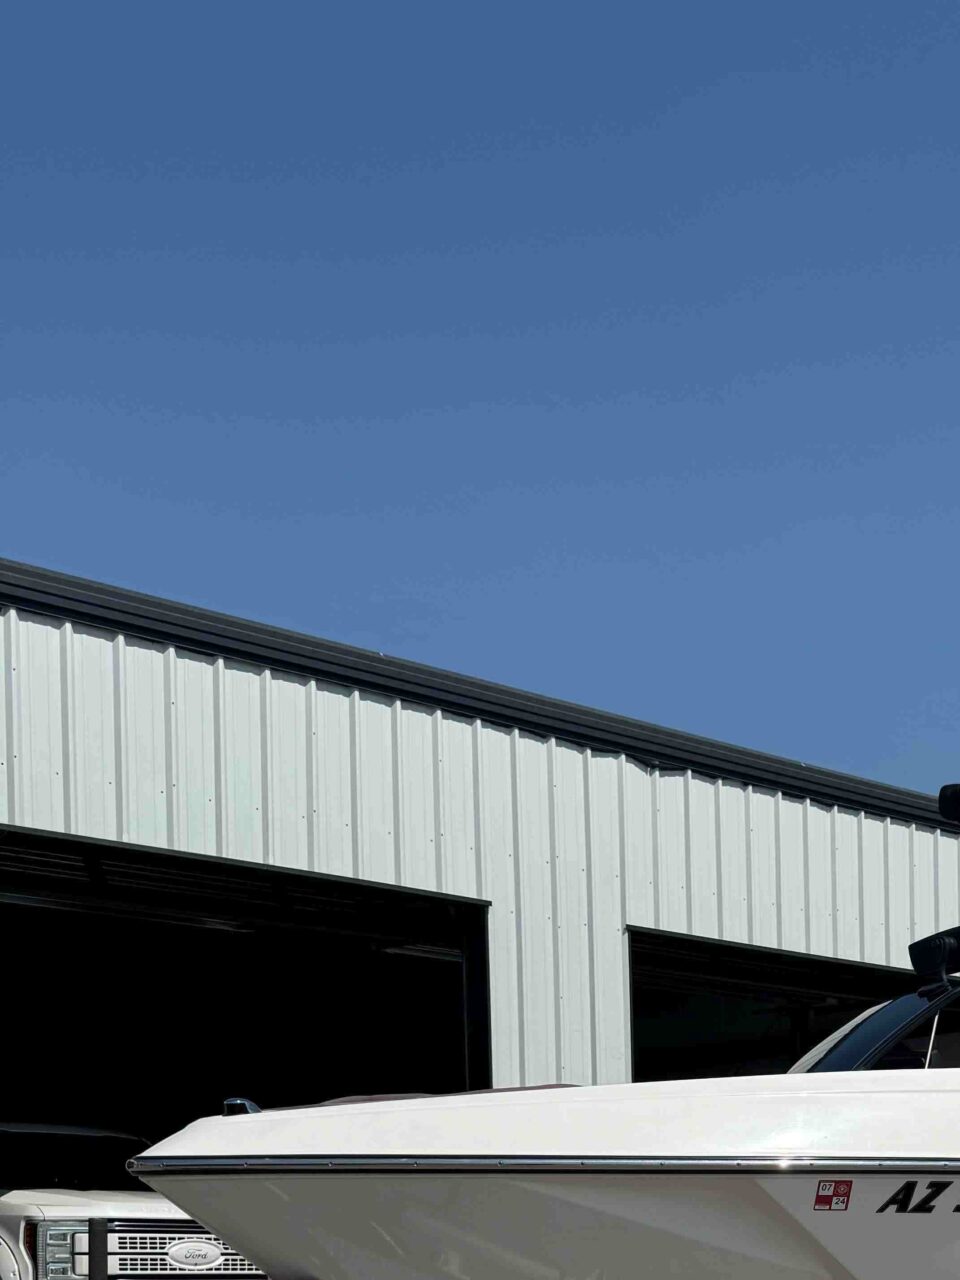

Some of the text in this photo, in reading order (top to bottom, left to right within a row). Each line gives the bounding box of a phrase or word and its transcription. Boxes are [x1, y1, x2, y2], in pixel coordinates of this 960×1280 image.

[821, 1183, 833, 1192] 07
[834, 1197, 846, 1205] 24
[875, 1180, 954, 1213] AZ
[184, 1248, 209, 1260] Ford
